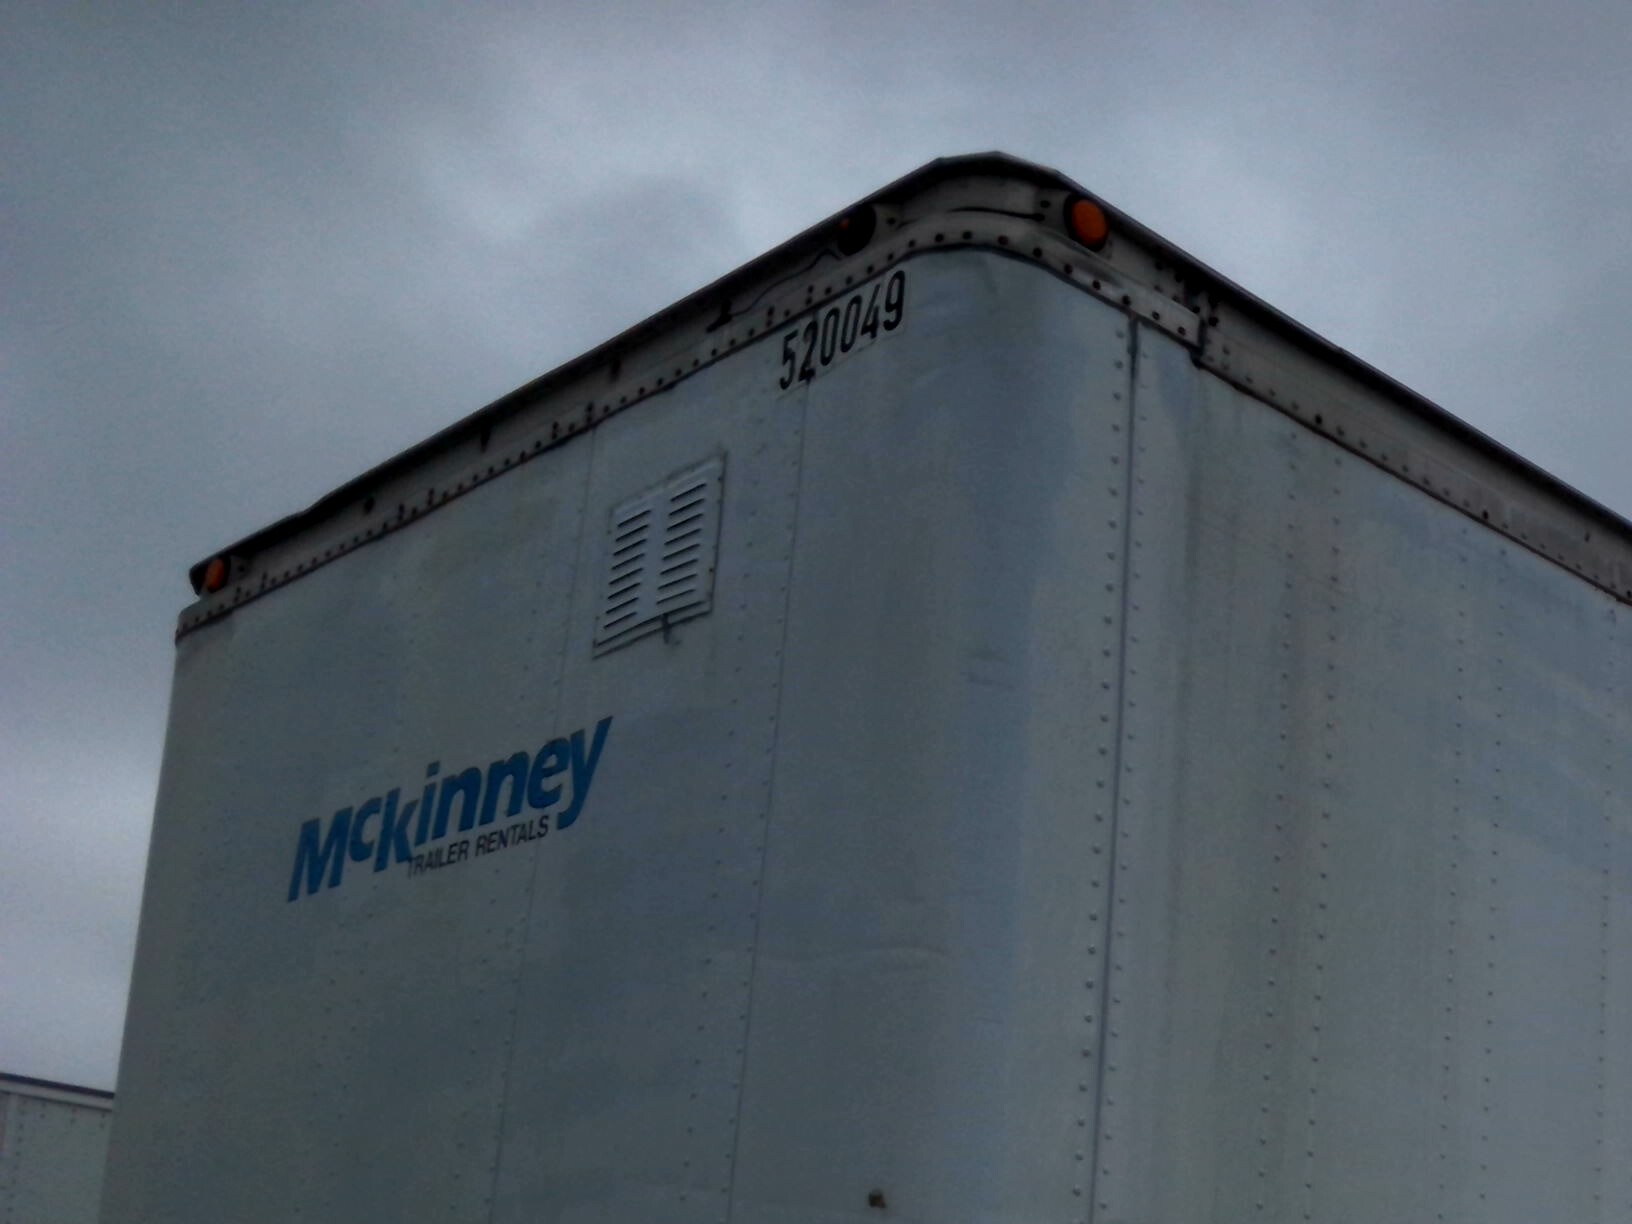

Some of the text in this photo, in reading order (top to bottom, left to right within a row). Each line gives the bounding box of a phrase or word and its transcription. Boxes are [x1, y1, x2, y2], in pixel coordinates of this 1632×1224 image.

[780, 270, 906, 390] 520049
[407, 814, 550, 878] TRAILER RENTALS
